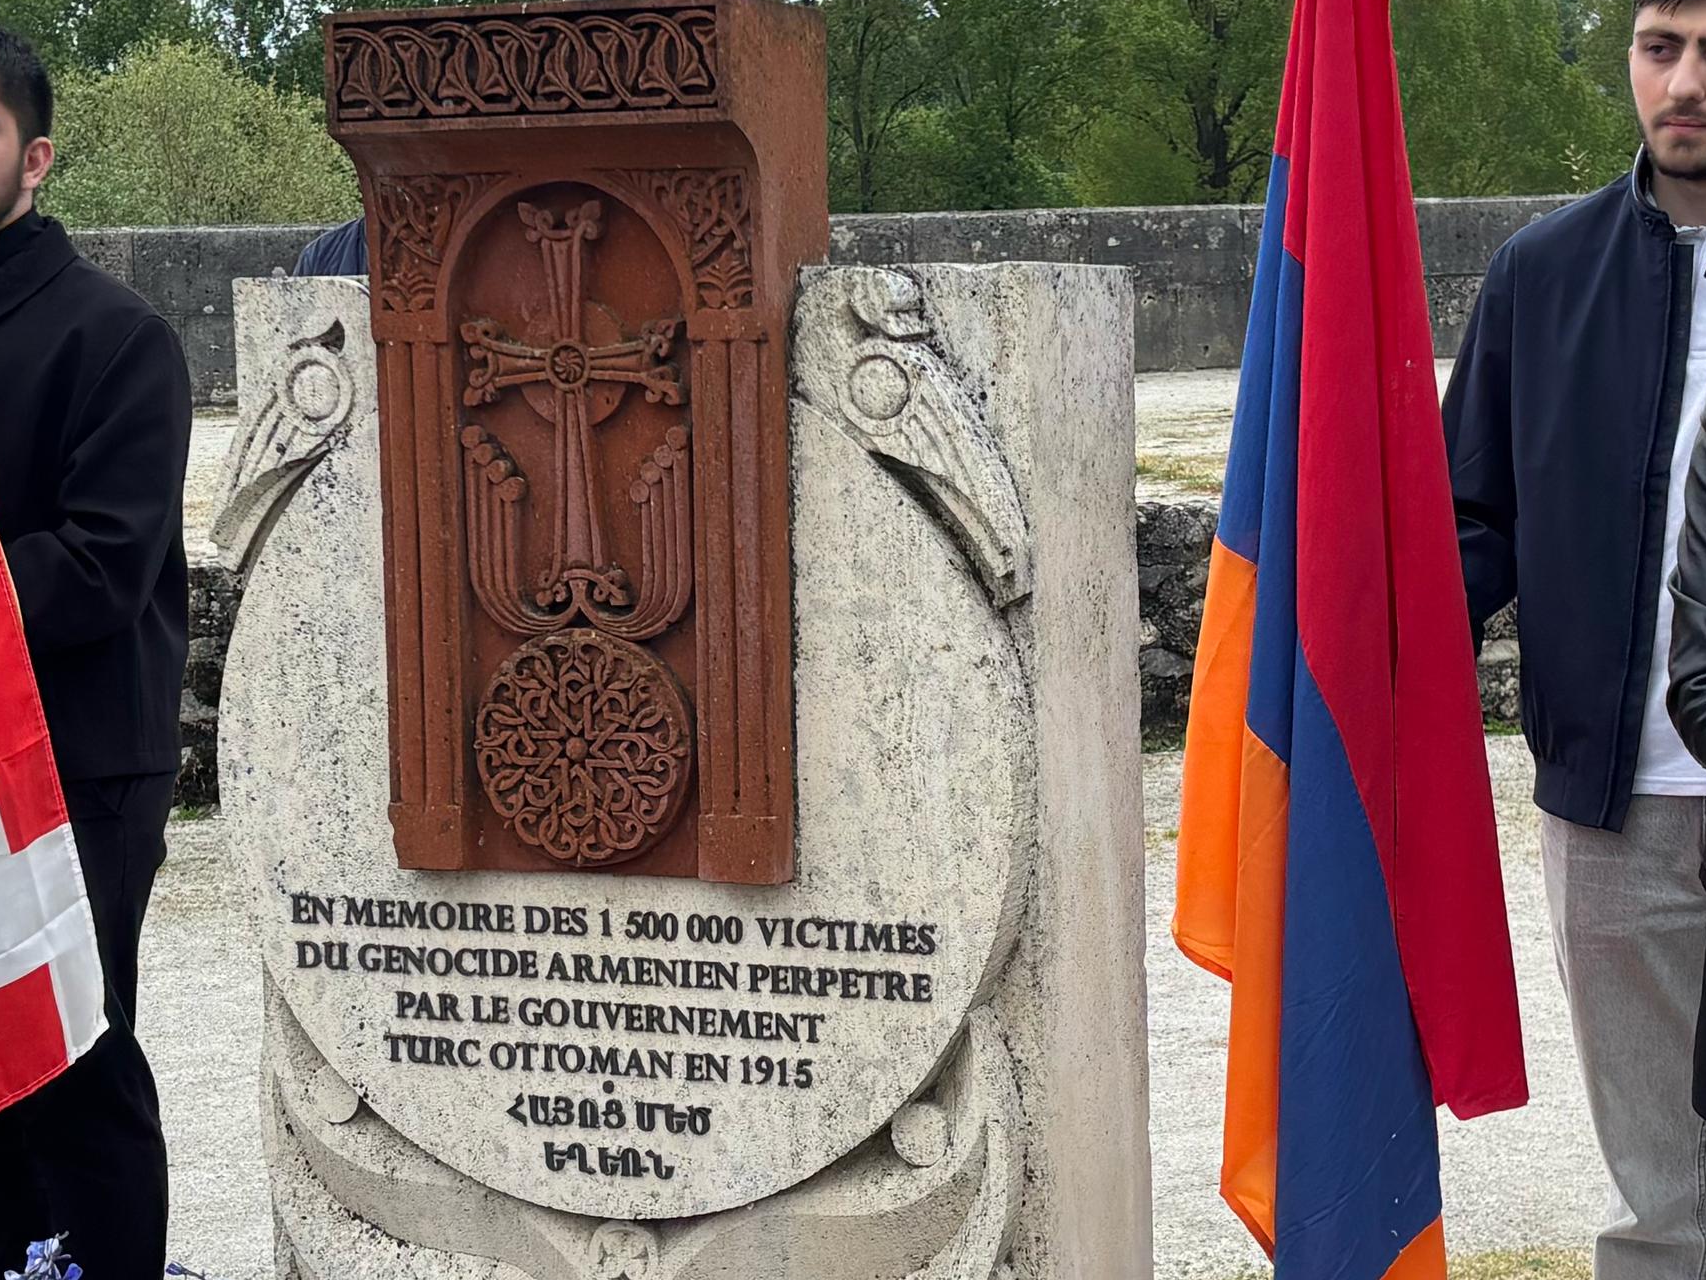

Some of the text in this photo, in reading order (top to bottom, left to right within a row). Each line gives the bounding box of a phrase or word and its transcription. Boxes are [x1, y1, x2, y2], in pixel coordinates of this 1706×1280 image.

[291, 894, 937, 956] EN MEMOIRE DES 1 500 000 VICTIMES
[295, 940, 934, 1004] DU GENOCIDE ARMENIEN PERPETRE
[394, 990, 827, 1044] PAR LE GOUVERNEMENT
[384, 1032, 814, 1090] TURC OTTOMAN EN 1915
